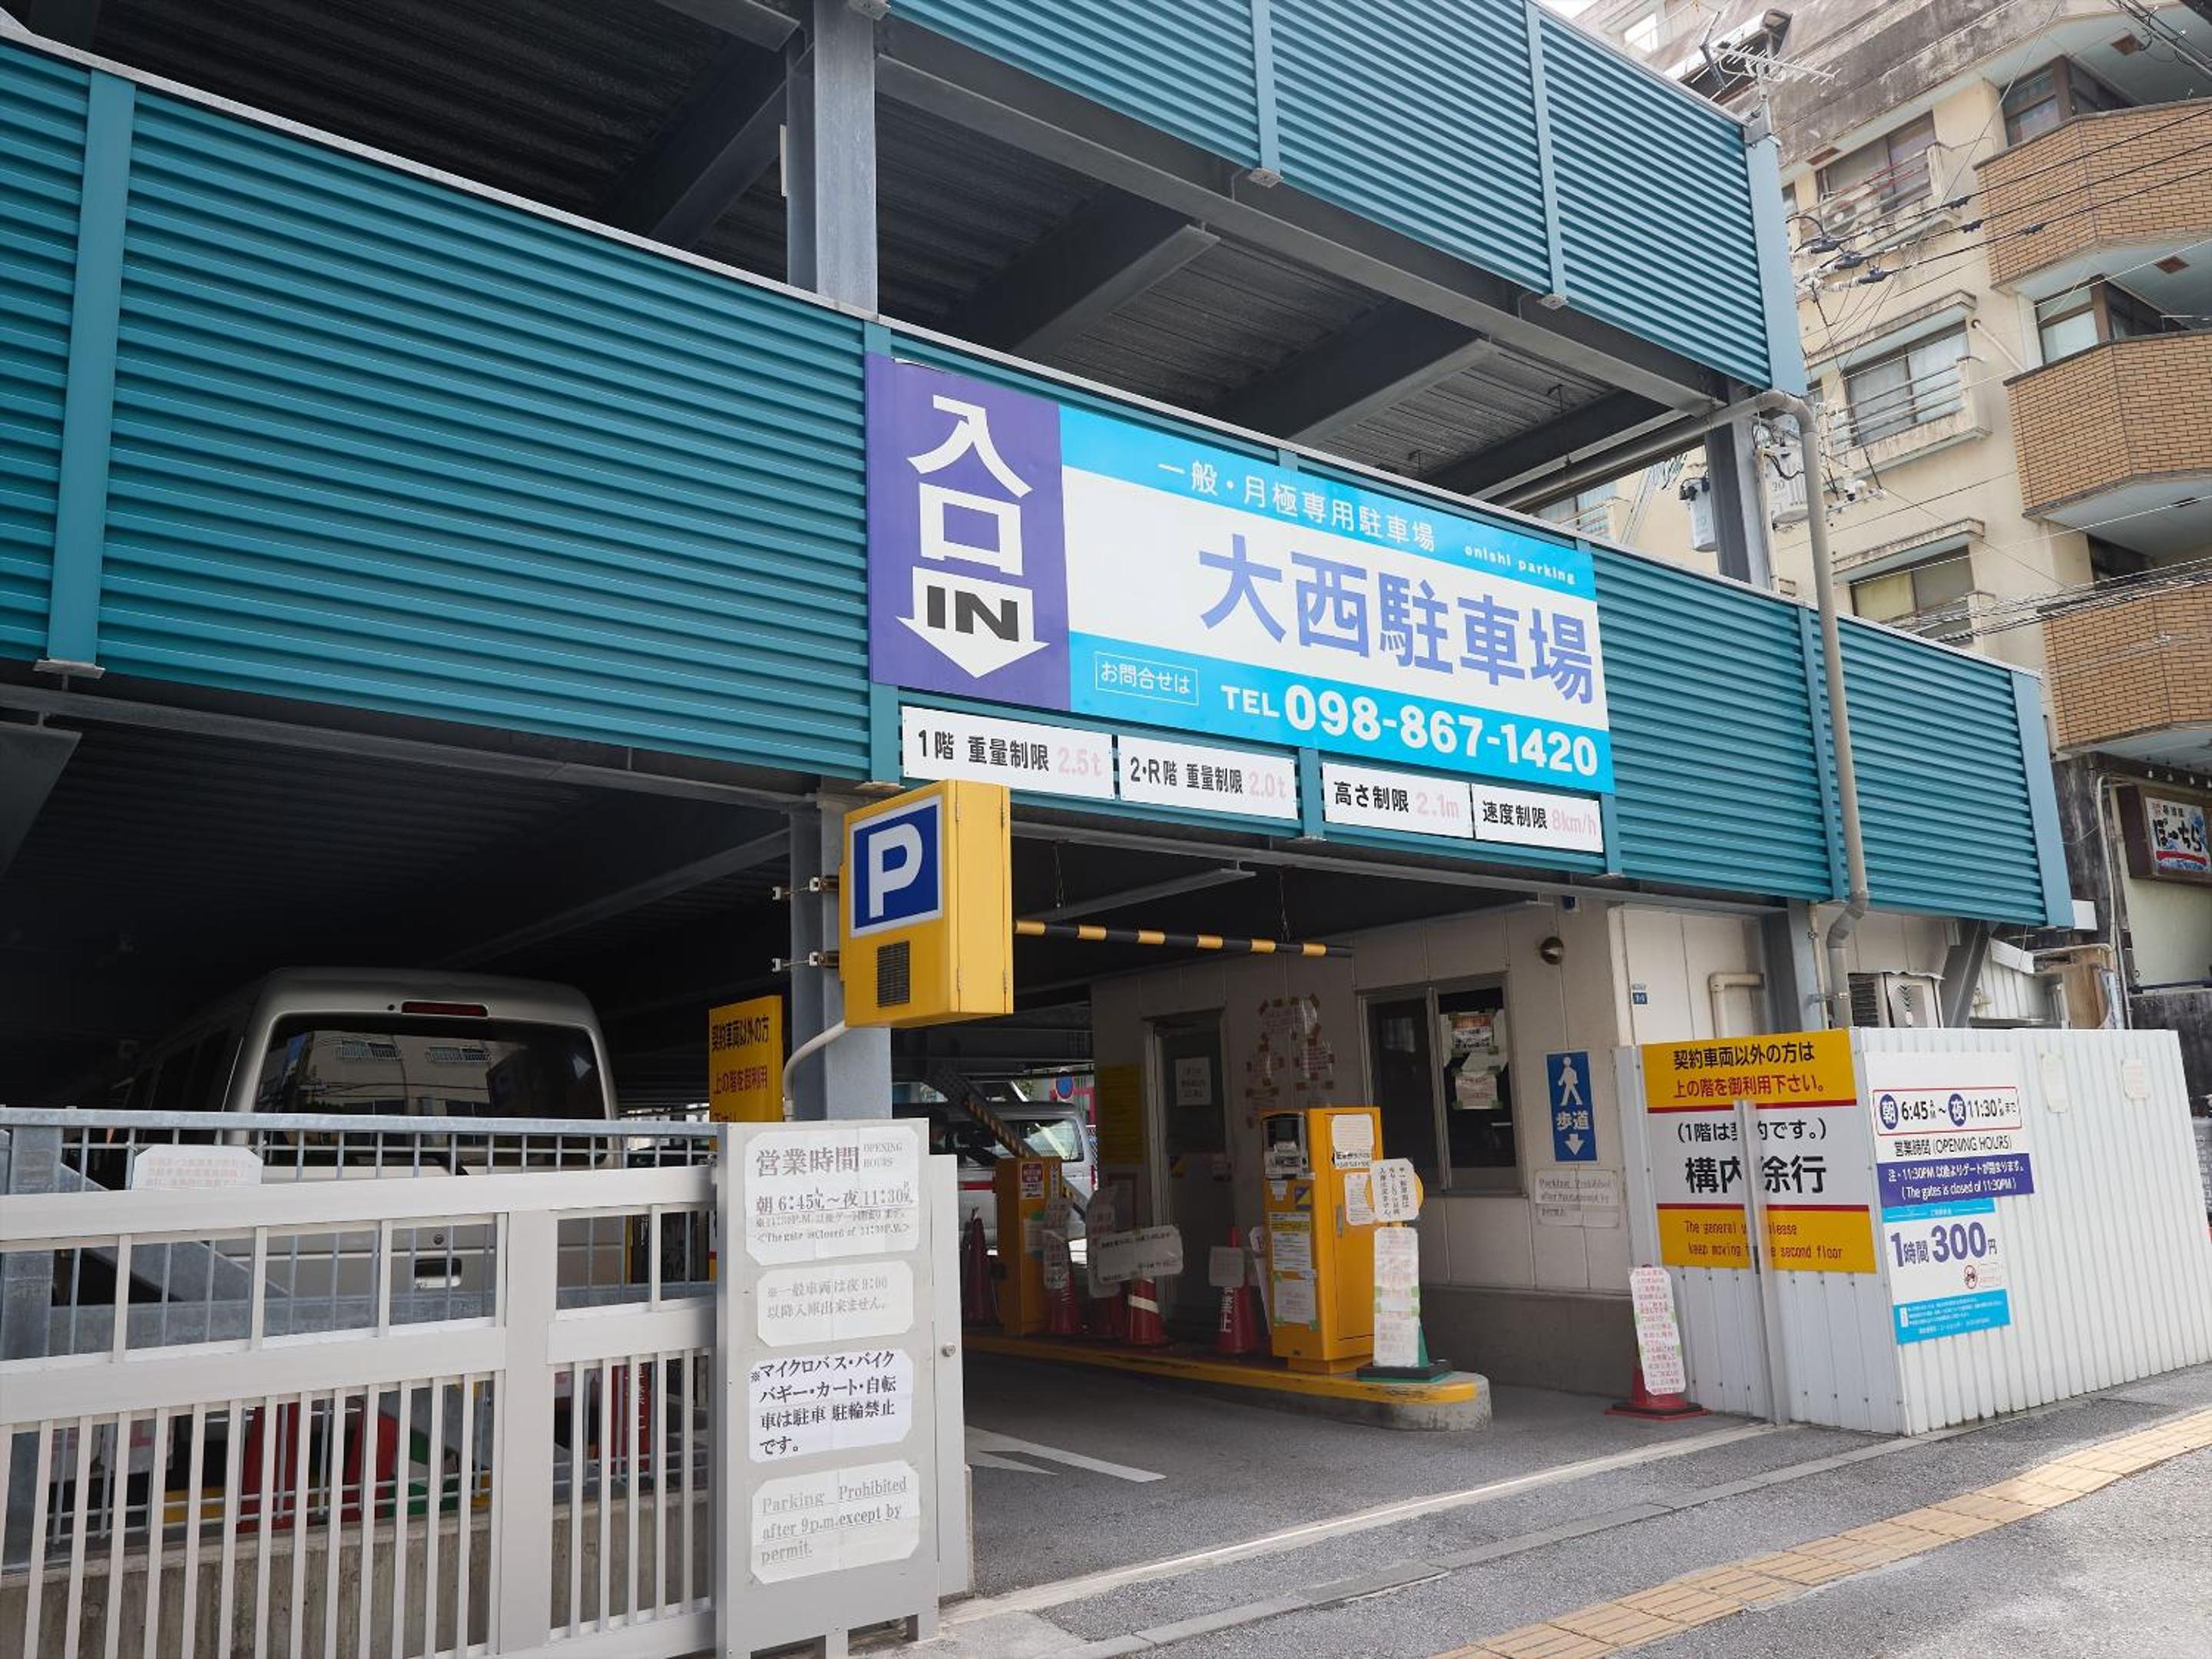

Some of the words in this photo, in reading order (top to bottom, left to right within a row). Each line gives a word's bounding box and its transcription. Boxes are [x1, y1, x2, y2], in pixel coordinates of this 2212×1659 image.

[907, 395, 1031, 576] 入口
[1157, 462, 1435, 552] 一般・月極専用駐車場
[1465, 545, 1511, 566] onishi
[1518, 560, 1576, 585] parking
[927, 584, 1018, 641] IN
[1198, 534, 1593, 704] 大西駐車場
[1100, 664, 1191, 694] お問合せは
[1221, 685, 1280, 718] TEL
[1285, 685, 1598, 776] 098-867-1420
[919, 730, 954, 760] 1階
[968, 736, 1049, 771] 重量制限
[1058, 747, 1101, 776] 2.5t
[1187, 763, 1243, 793] 重量制限
[1249, 771, 1286, 799] 2.0t
[1334, 781, 1409, 813] 高さ制限
[1416, 792, 1459, 820] 2.1m
[1483, 800, 1548, 830] 速度制限
[1551, 811, 1597, 837] 8km/h
[869, 823, 922, 919] P
[1674, 1042, 1815, 1071] 契約車両以外の方は
[1674, 1075, 1824, 1098] 上の階を御利用下さい。
[1556, 1112, 1589, 1131] 歩道
[1902, 1101, 1929, 1121] 6:45
[1950, 1099, 1965, 1121] 夜
[1967, 1099, 1998, 1118] 11:30
[756, 1147, 859, 1177] 営業時間
[863, 1142, 903, 1153] OPENING
[863, 1158, 894, 1169] HOURS
[779, 1193, 814, 1212] 6:45
[864, 1190, 902, 1207] 11:30
[1684, 1220, 1700, 1233] The
[1704, 1221, 1737, 1235] general
[1711, 1243, 1742, 1258] moving
[1781, 1245, 1812, 1260] second
[1816, 1247, 1843, 1260] floor
[759, 1375, 897, 1403] バギー・カート・自転
[760, 1407, 826, 1430] 車は駐車
[832, 1399, 896, 1422] 駐輪禁止
[759, 1435, 799, 1455] です。
[763, 1492, 826, 1514] Parking
[838, 1476, 908, 1500] Prohibited
[762, 1520, 797, 1538] after
[886, 1503, 902, 1520] by
[761, 1541, 813, 1565] permit.
